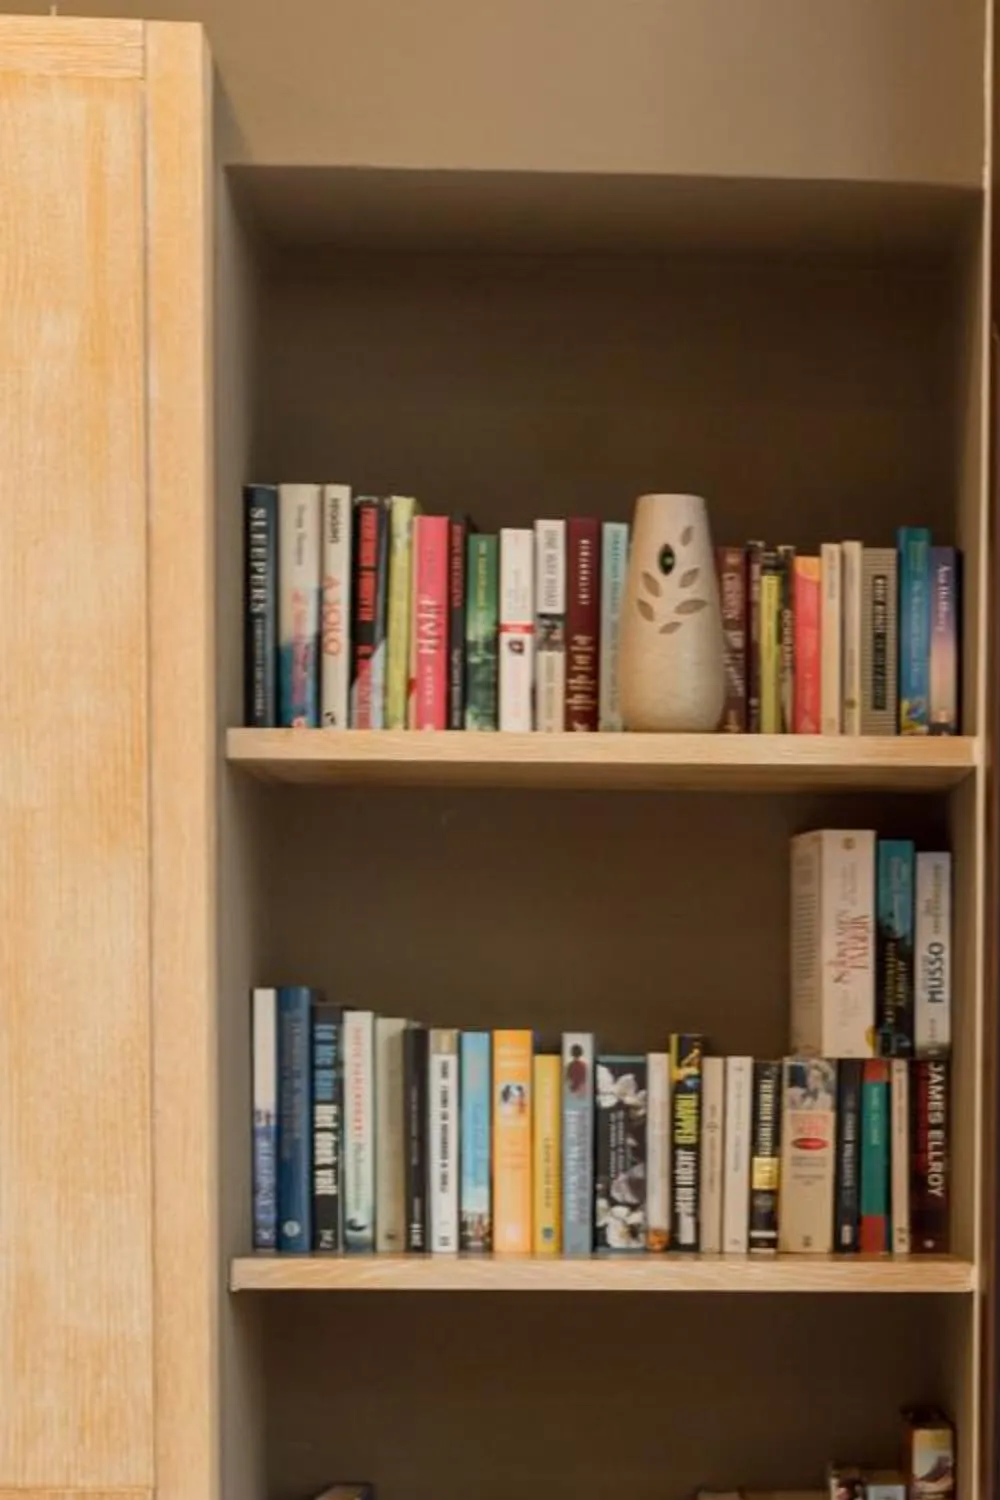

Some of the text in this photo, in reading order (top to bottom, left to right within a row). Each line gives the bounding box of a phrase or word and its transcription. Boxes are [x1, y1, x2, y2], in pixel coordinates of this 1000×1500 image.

[250, 507, 268, 614] SLEEPERS
[927, 942, 944, 1003] MUSSO
[674, 1094, 698, 1145] TRAPPED
[927, 1062, 945, 1198] JAMES ELLROY
